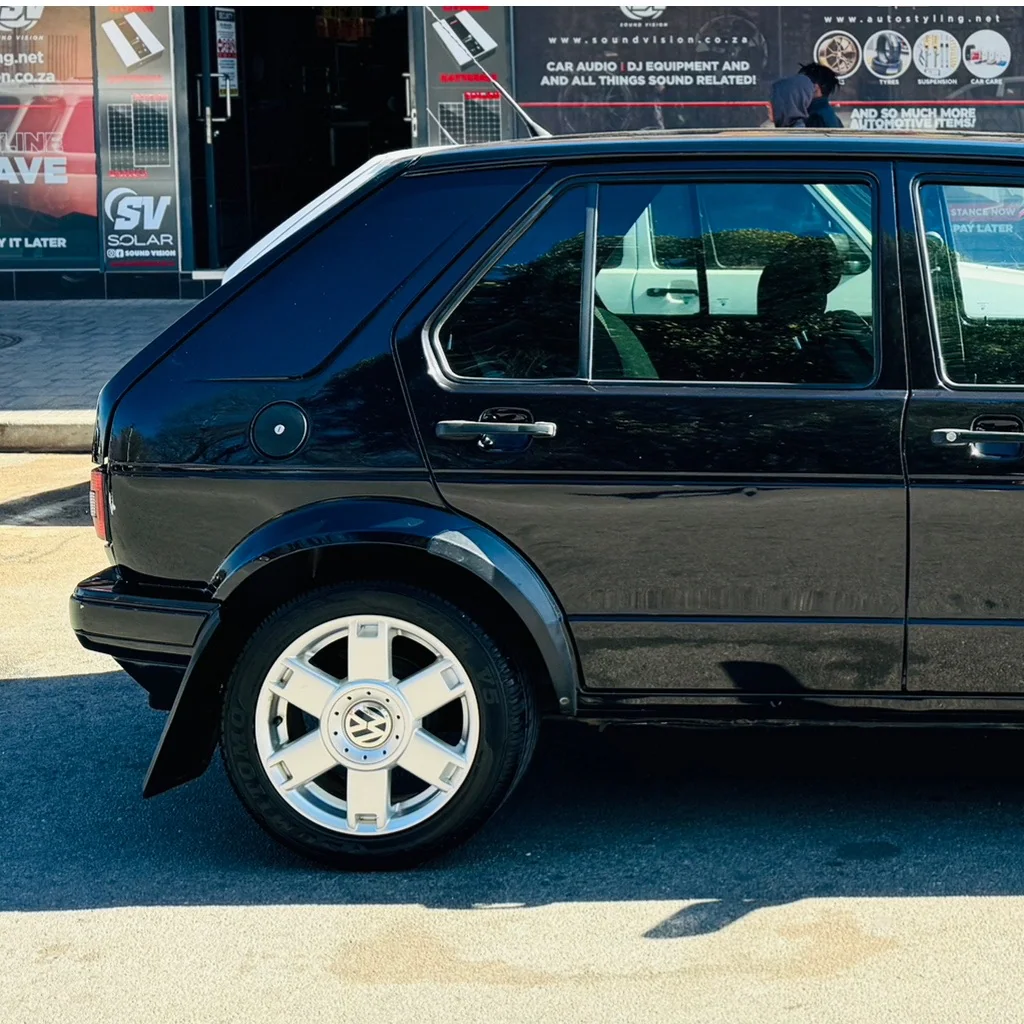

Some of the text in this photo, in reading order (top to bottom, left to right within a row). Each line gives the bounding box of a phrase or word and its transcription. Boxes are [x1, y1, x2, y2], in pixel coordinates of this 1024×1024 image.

[546, 61, 750, 72] CAR AUDIO DJ EQUIPMENT AND
[541, 75, 757, 86] AND ALL THINGS SOUND RELATED!
[850, 108, 976, 119] AND SO MUCH MORE
[850, 118, 932, 129] AUTOMOTIVE
[114, 196, 172, 230] SV
[991, 207, 1016, 216] NOW
[953, 224, 1014, 233] PAY LATER
[9, 238, 22, 247] IT
[24, 238, 67, 248] LATER
[107, 234, 174, 246] SOLAR
[125, 249, 150, 257] SOUND
